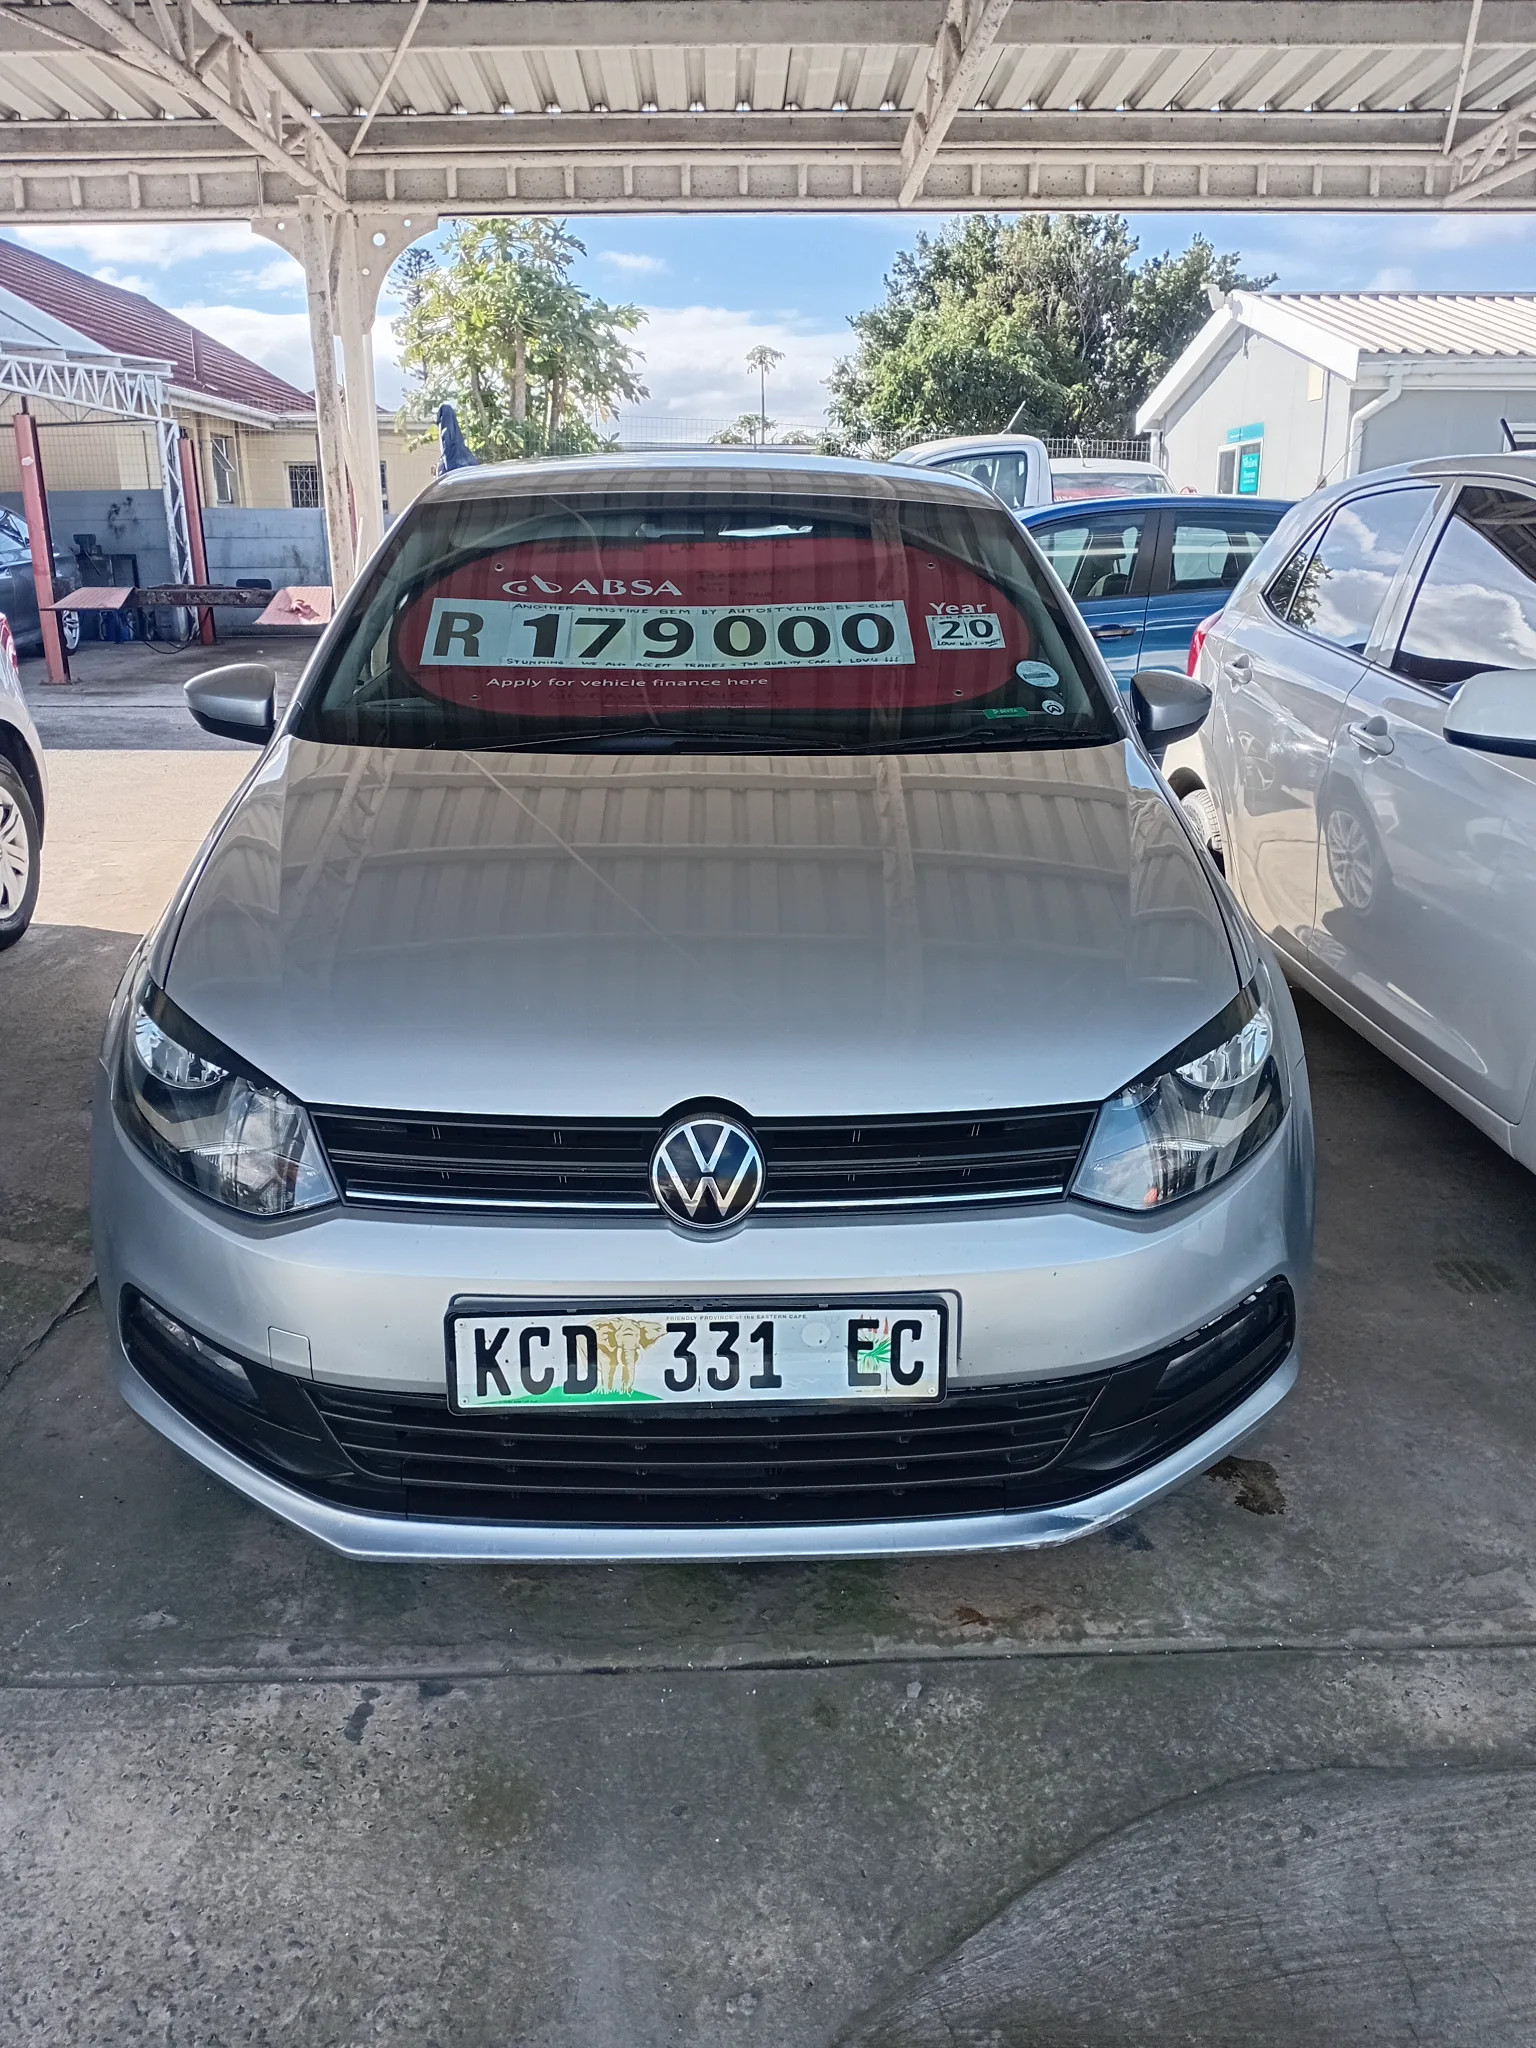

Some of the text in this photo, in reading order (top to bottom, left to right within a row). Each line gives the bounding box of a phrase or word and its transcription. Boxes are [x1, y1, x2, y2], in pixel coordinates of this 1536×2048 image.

[569, 579, 682, 596] ABSA
[513, 603, 576, 611] ANOTHER
[929, 602, 987, 615] Year
[432, 610, 895, 659] R 179000
[938, 619, 994, 639] 20
[486, 676, 768, 688] Apply for vehicle finance here
[473, 1318, 924, 1397] KCD 331 EC
